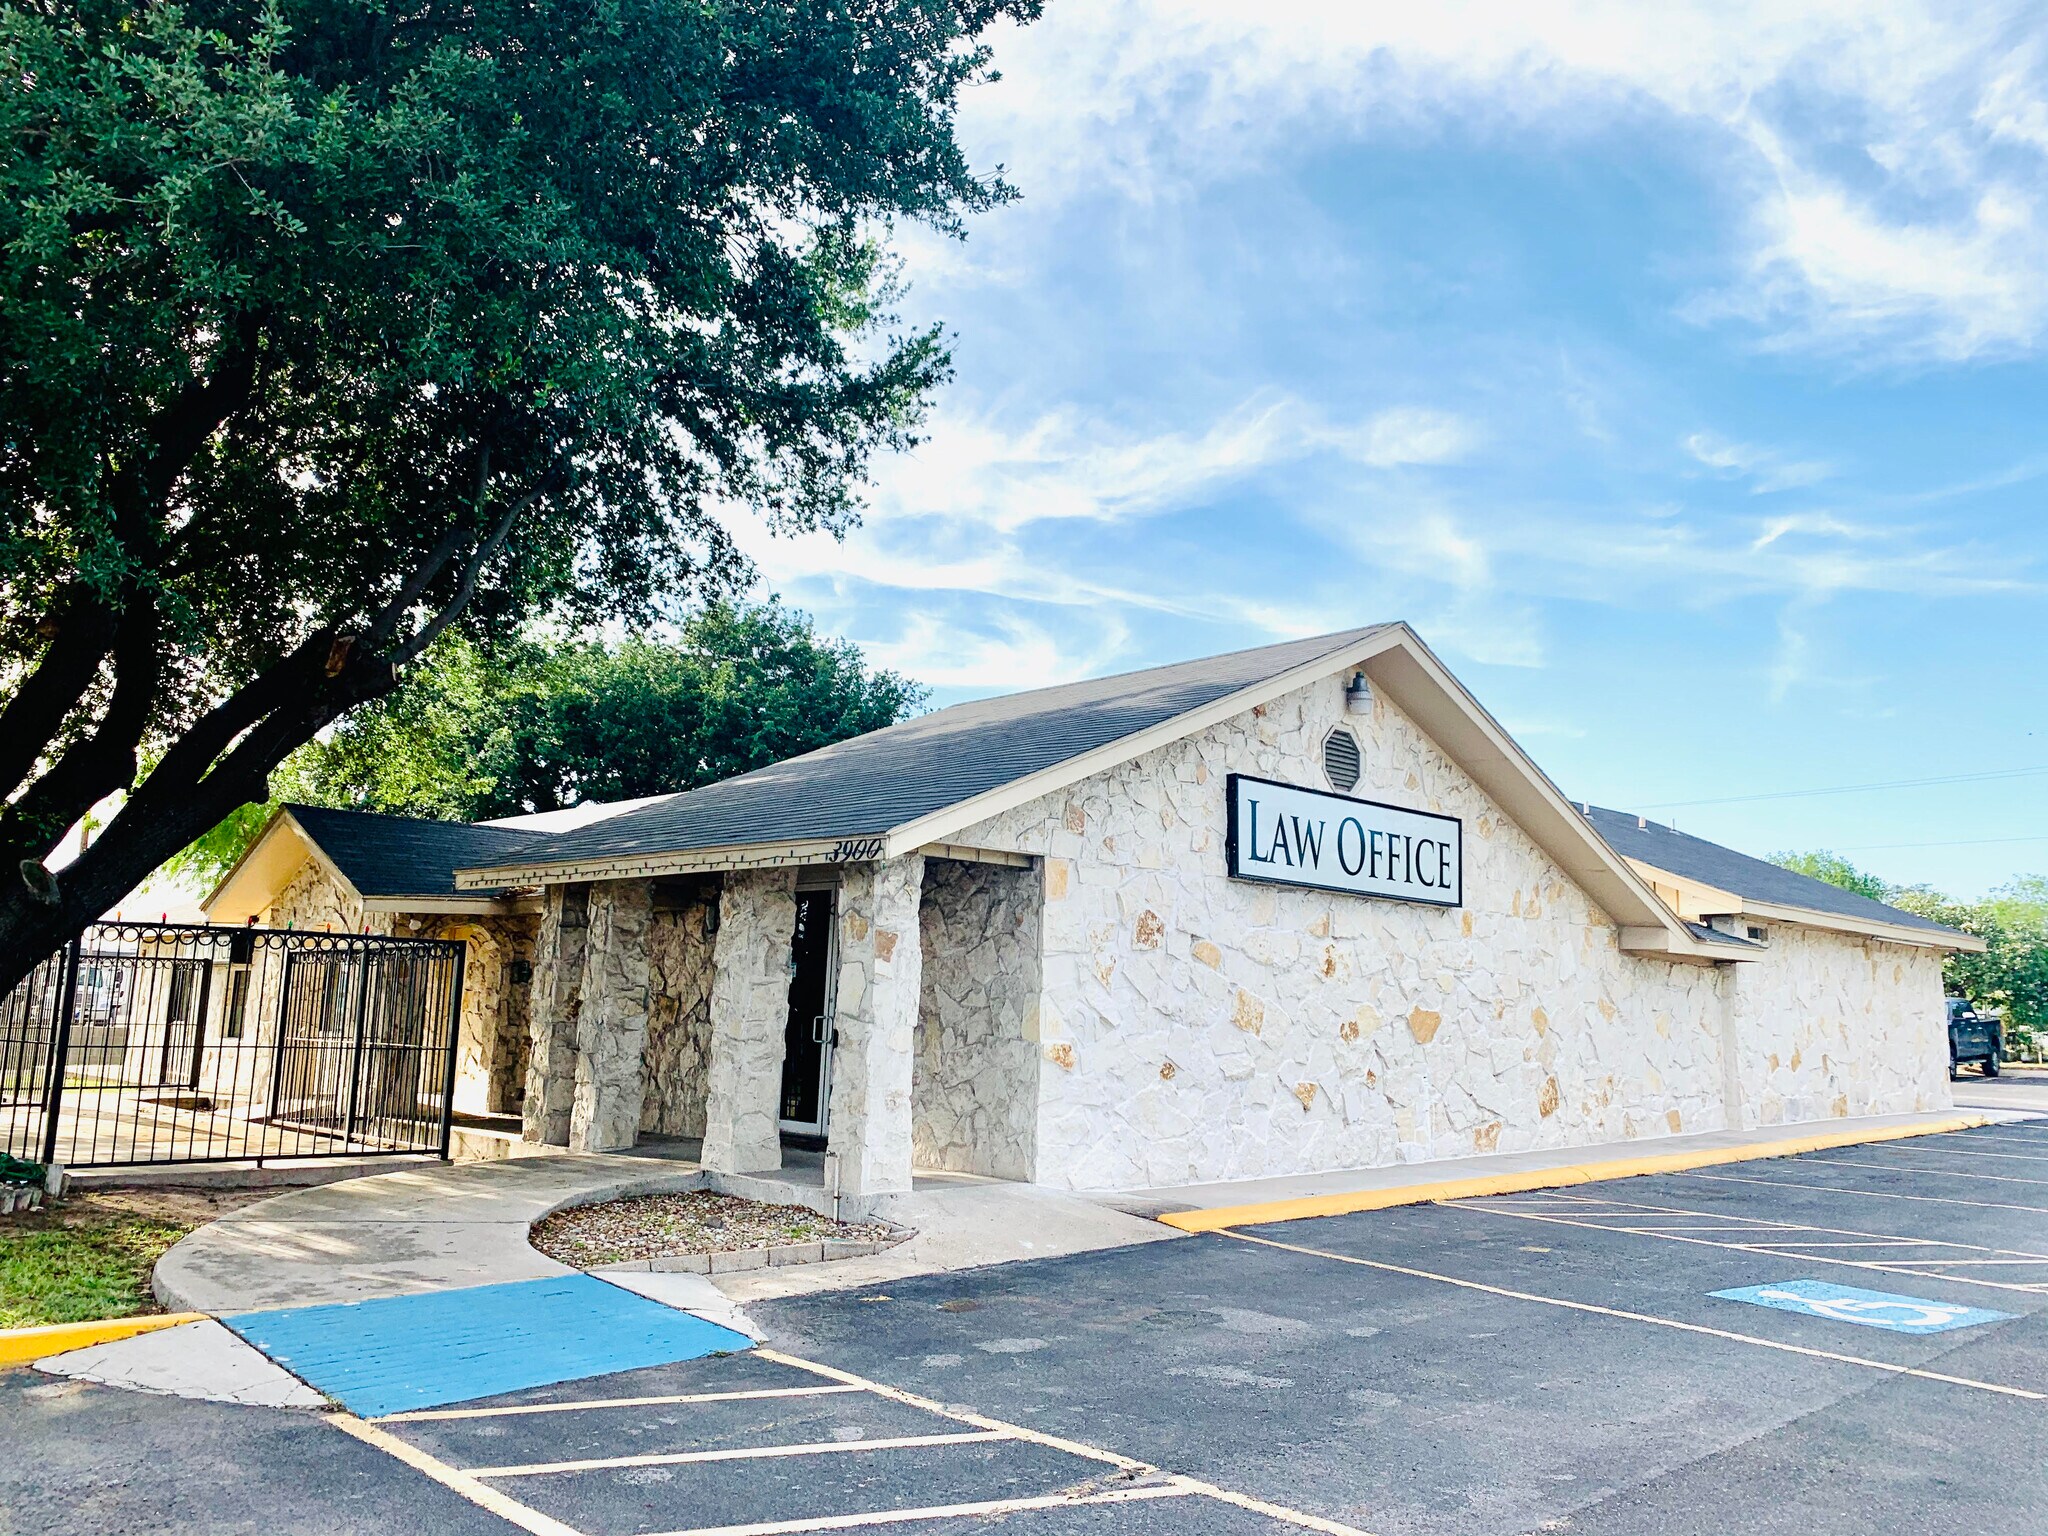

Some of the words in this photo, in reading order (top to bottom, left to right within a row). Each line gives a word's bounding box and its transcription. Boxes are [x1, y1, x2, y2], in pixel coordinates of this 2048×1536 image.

[829, 838, 882, 862] 3900
[1248, 799, 1326, 870] LAW
[1337, 817, 1451, 889] OFFICE
